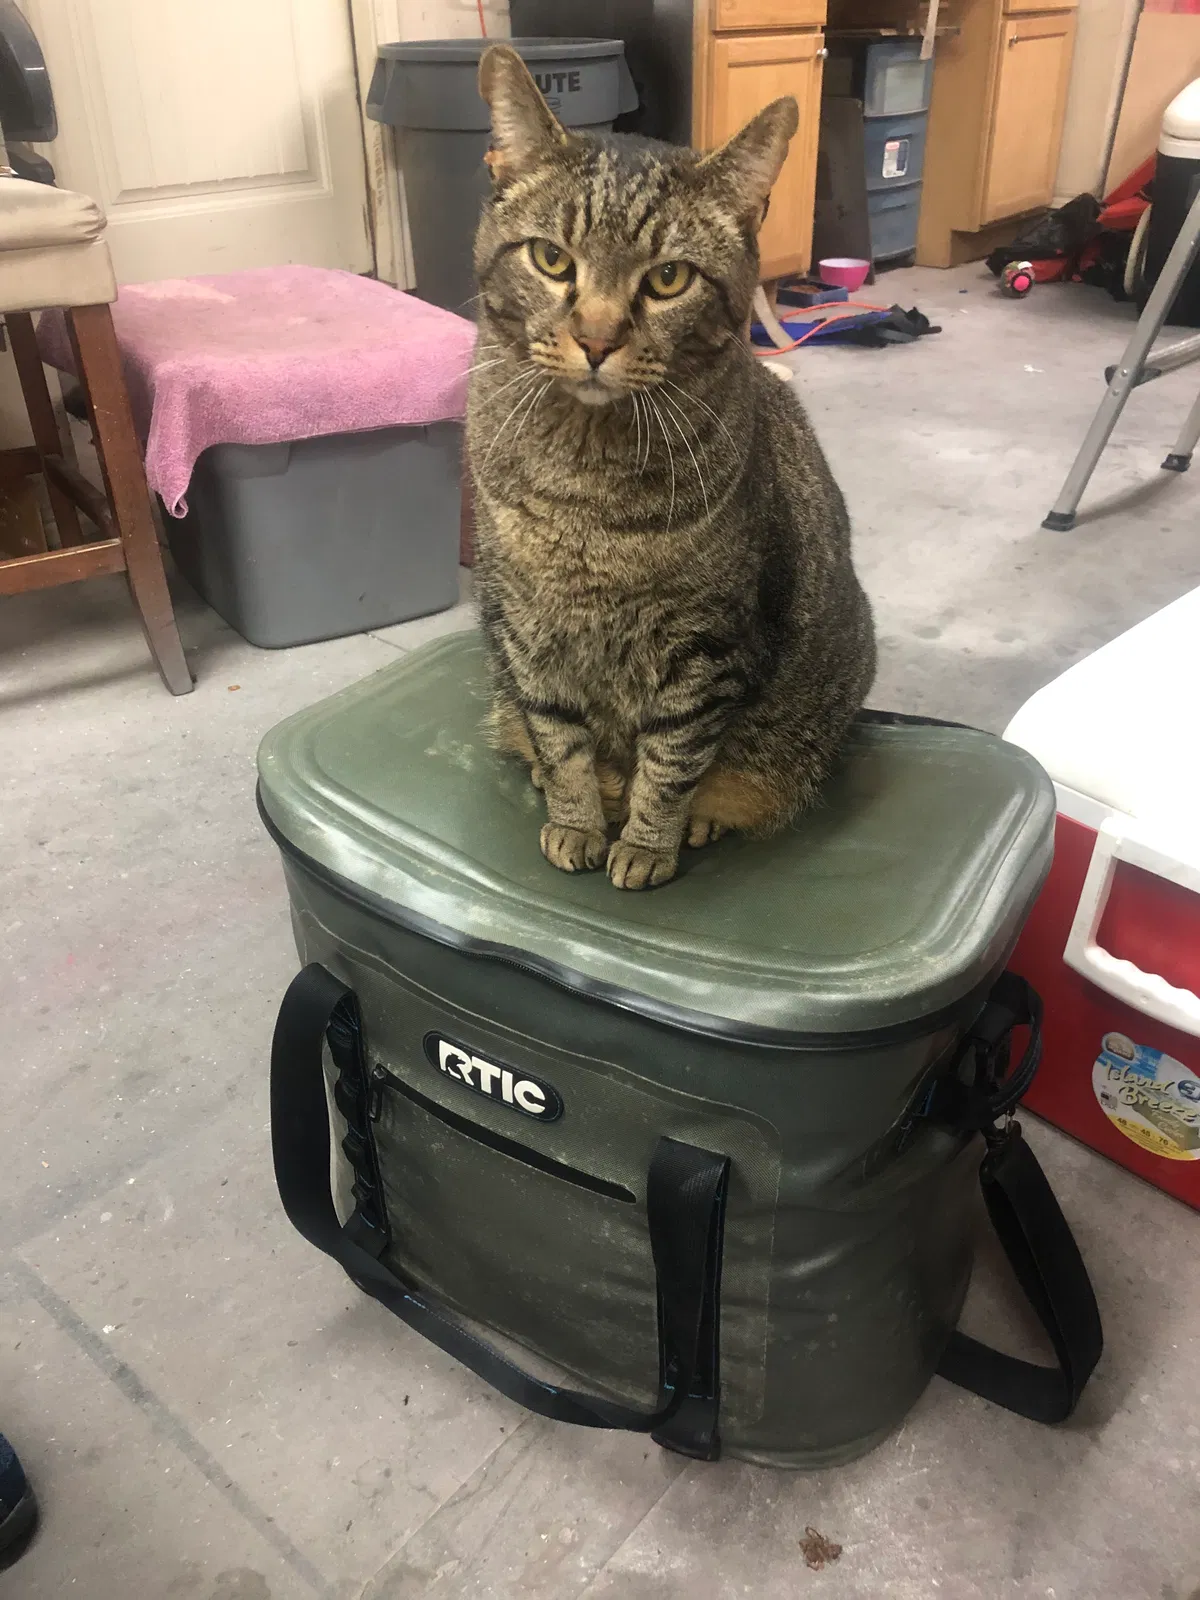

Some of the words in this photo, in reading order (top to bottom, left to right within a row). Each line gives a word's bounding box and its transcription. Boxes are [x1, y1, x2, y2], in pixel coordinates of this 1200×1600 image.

[535, 71, 581, 94] UTE
[438, 1039, 546, 1114] RTIC
[1105, 1060, 1176, 1095] Island
